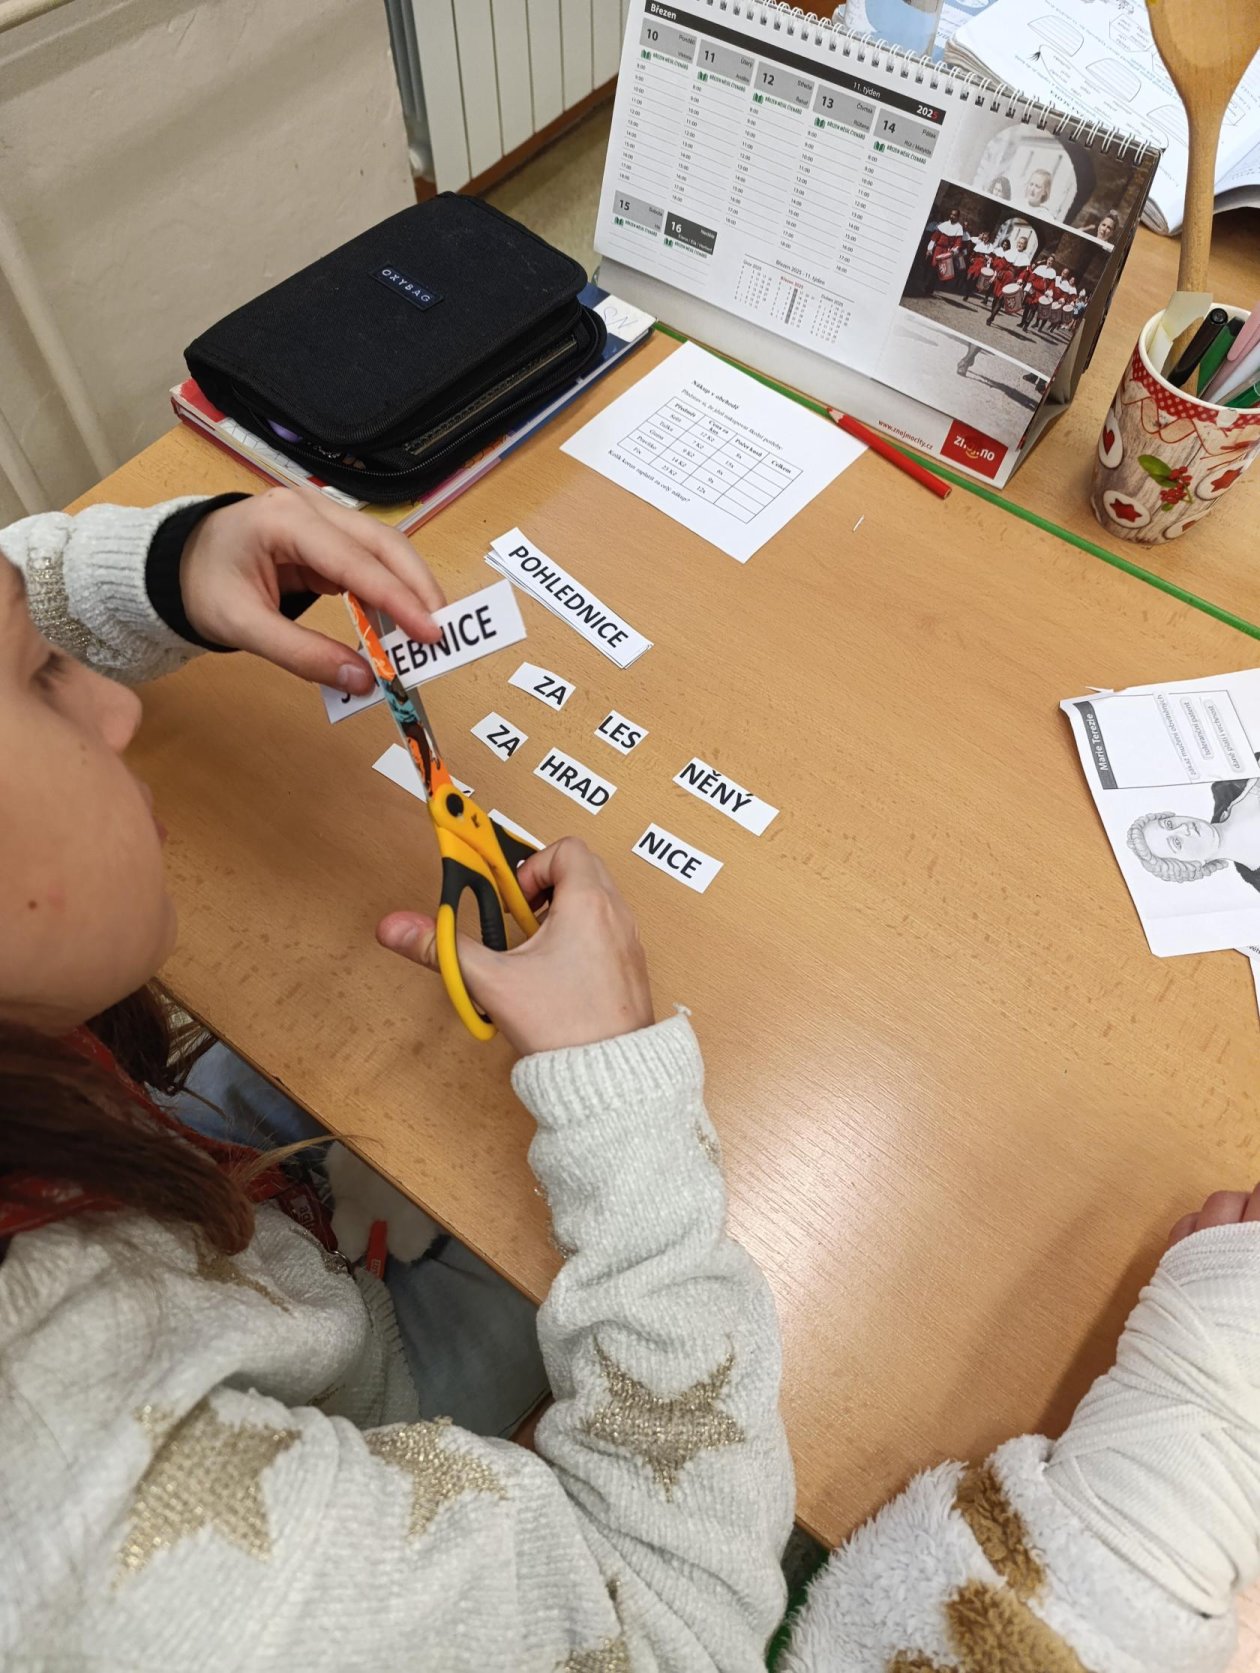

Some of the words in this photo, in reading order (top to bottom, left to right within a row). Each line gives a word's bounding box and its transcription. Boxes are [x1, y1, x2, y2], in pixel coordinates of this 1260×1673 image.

[650, 3, 677, 20] Březen
[646, 28, 658, 41] 10
[704, 50, 715, 63] 11
[762, 72, 775, 86] 12
[853, 82, 862, 92] 11.
[862, 86, 881, 98] týden
[822, 96, 834, 109] 13
[916, 104, 938, 120] 2025
[883, 120, 896, 134] 14
[620, 200, 630, 211] 15
[670, 222, 682, 233] 16
[382, 269, 430, 302] OXYBAG
[771, 460, 792, 474] Celkem
[508, 545, 629, 649] POHLEDNICE
[533, 676, 571, 706] ZA
[1184, 702, 1198, 724] patent
[598, 714, 640, 750] LES
[1086, 713, 1101, 744] Terezie
[486, 724, 522, 758] ZA
[1095, 745, 1109, 771] Marie
[539, 756, 610, 808] HRAD
[679, 762, 752, 814] NĚNÝ
[638, 832, 702, 880] NICE
